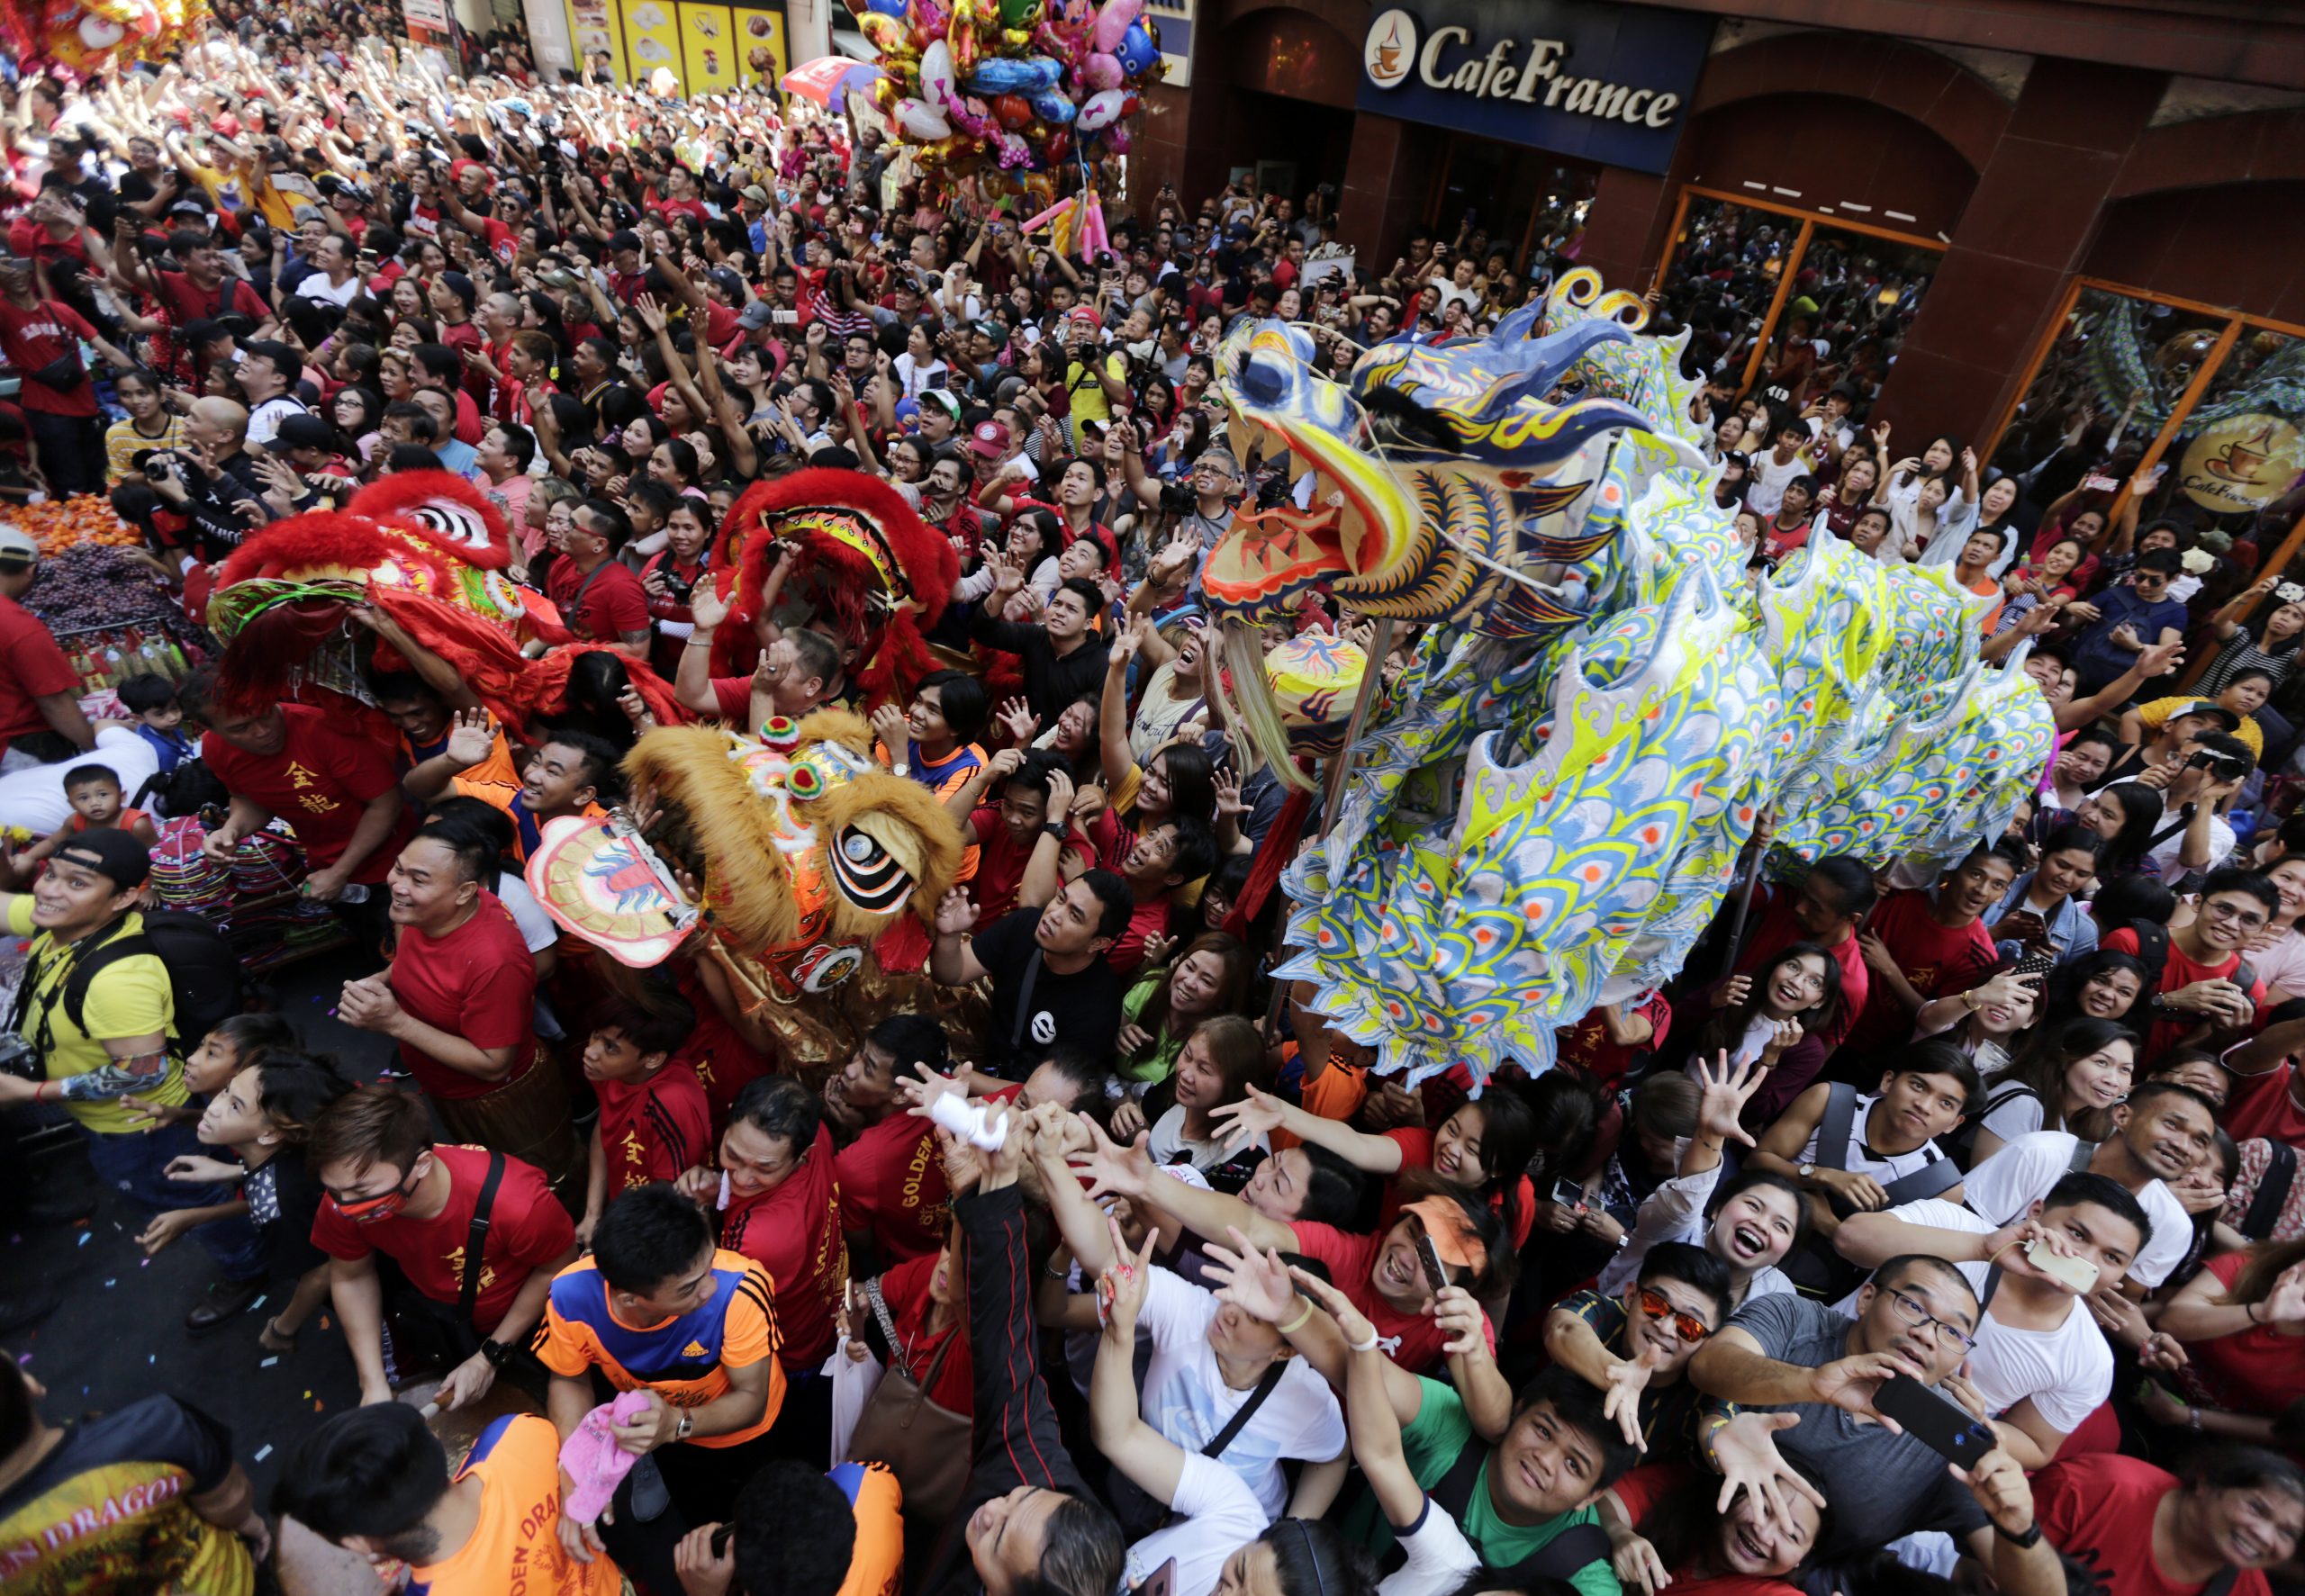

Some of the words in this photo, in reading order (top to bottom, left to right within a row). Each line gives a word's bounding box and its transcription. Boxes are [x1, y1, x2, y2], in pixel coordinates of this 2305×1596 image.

[1419, 25, 1680, 128] CafeFrance
[901, 1134, 934, 1208] GOLDEN
[520, 1487, 560, 1541] DRA
